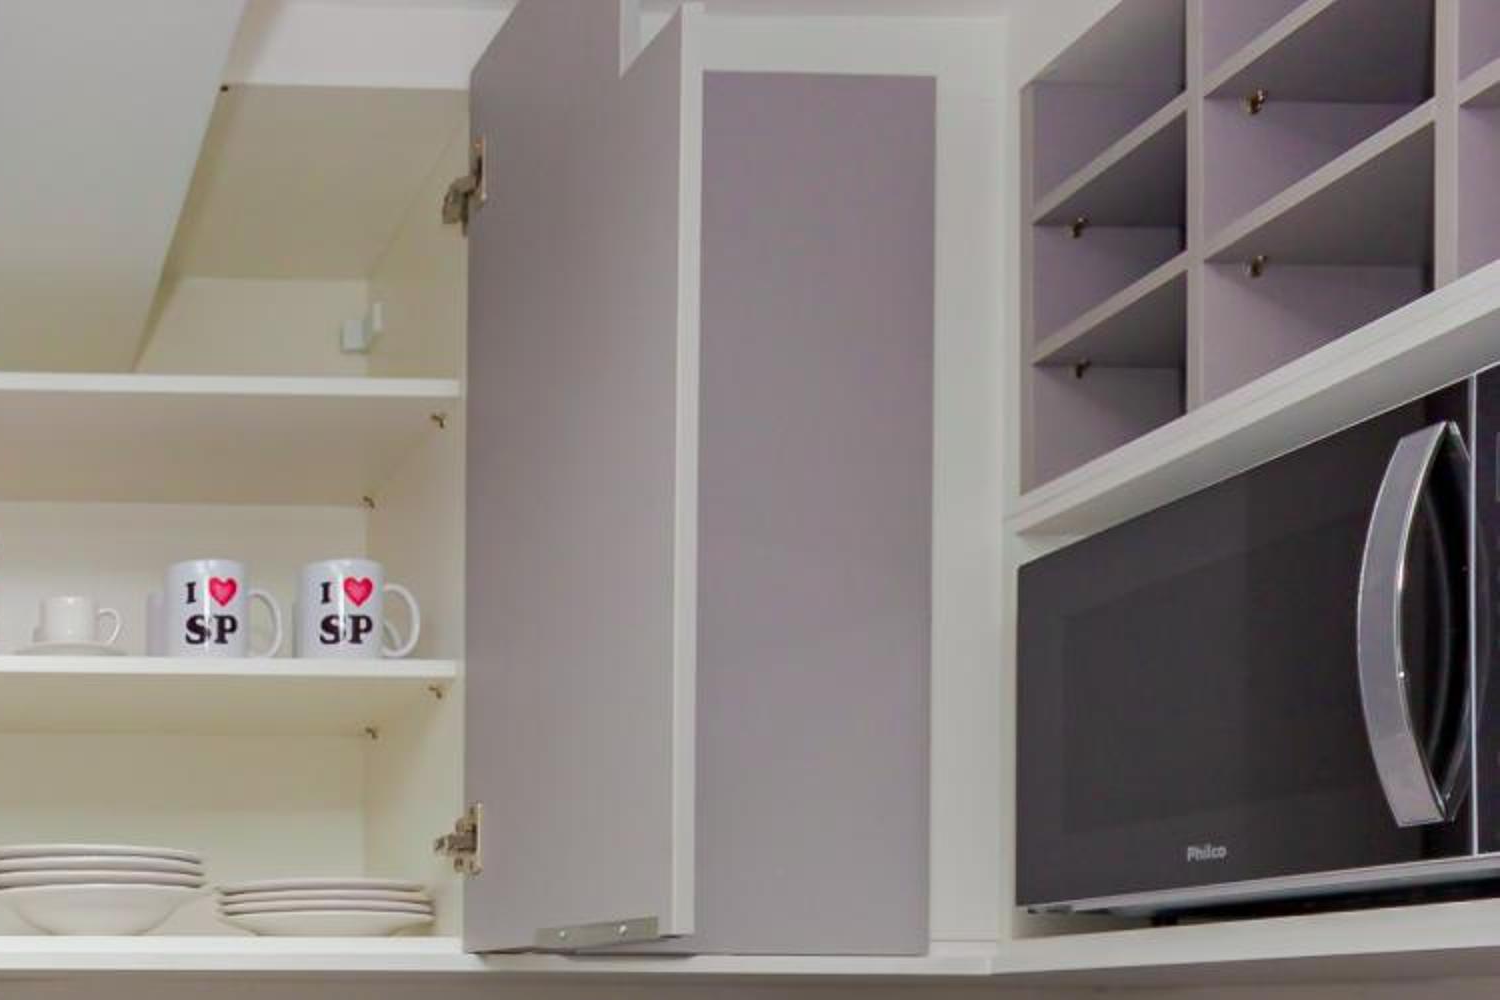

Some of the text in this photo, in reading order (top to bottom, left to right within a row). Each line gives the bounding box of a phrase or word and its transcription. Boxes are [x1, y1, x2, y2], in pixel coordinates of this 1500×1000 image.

[186, 582, 197, 604] I
[320, 581, 332, 604] I
[185, 614, 238, 645] SP
[319, 614, 373, 645] SP
